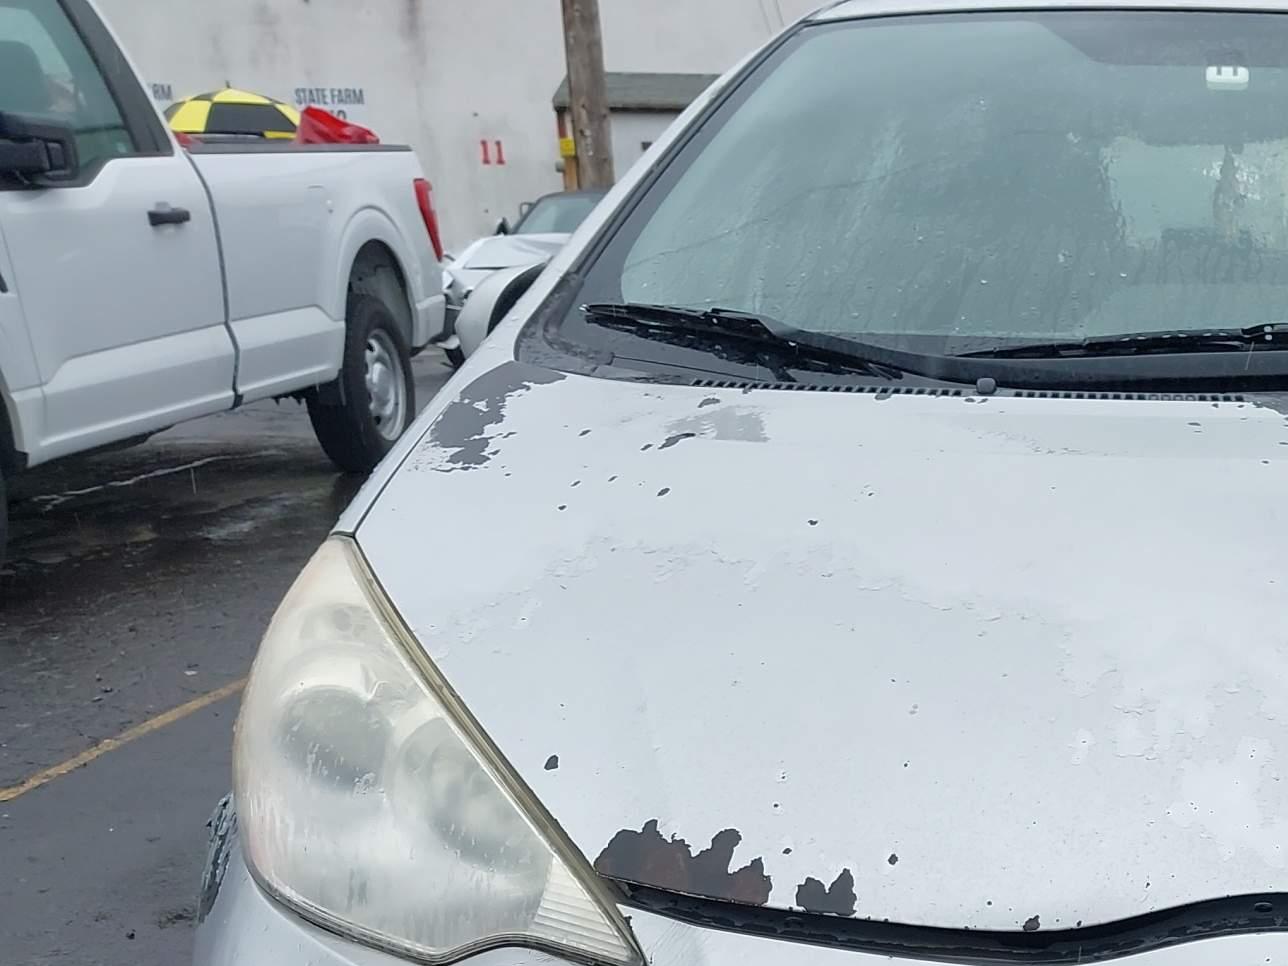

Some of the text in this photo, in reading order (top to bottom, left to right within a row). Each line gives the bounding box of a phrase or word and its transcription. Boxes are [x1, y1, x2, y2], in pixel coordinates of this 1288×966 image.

[295, 88, 365, 104] STATE FARM
[480, 140, 505, 165] 11
